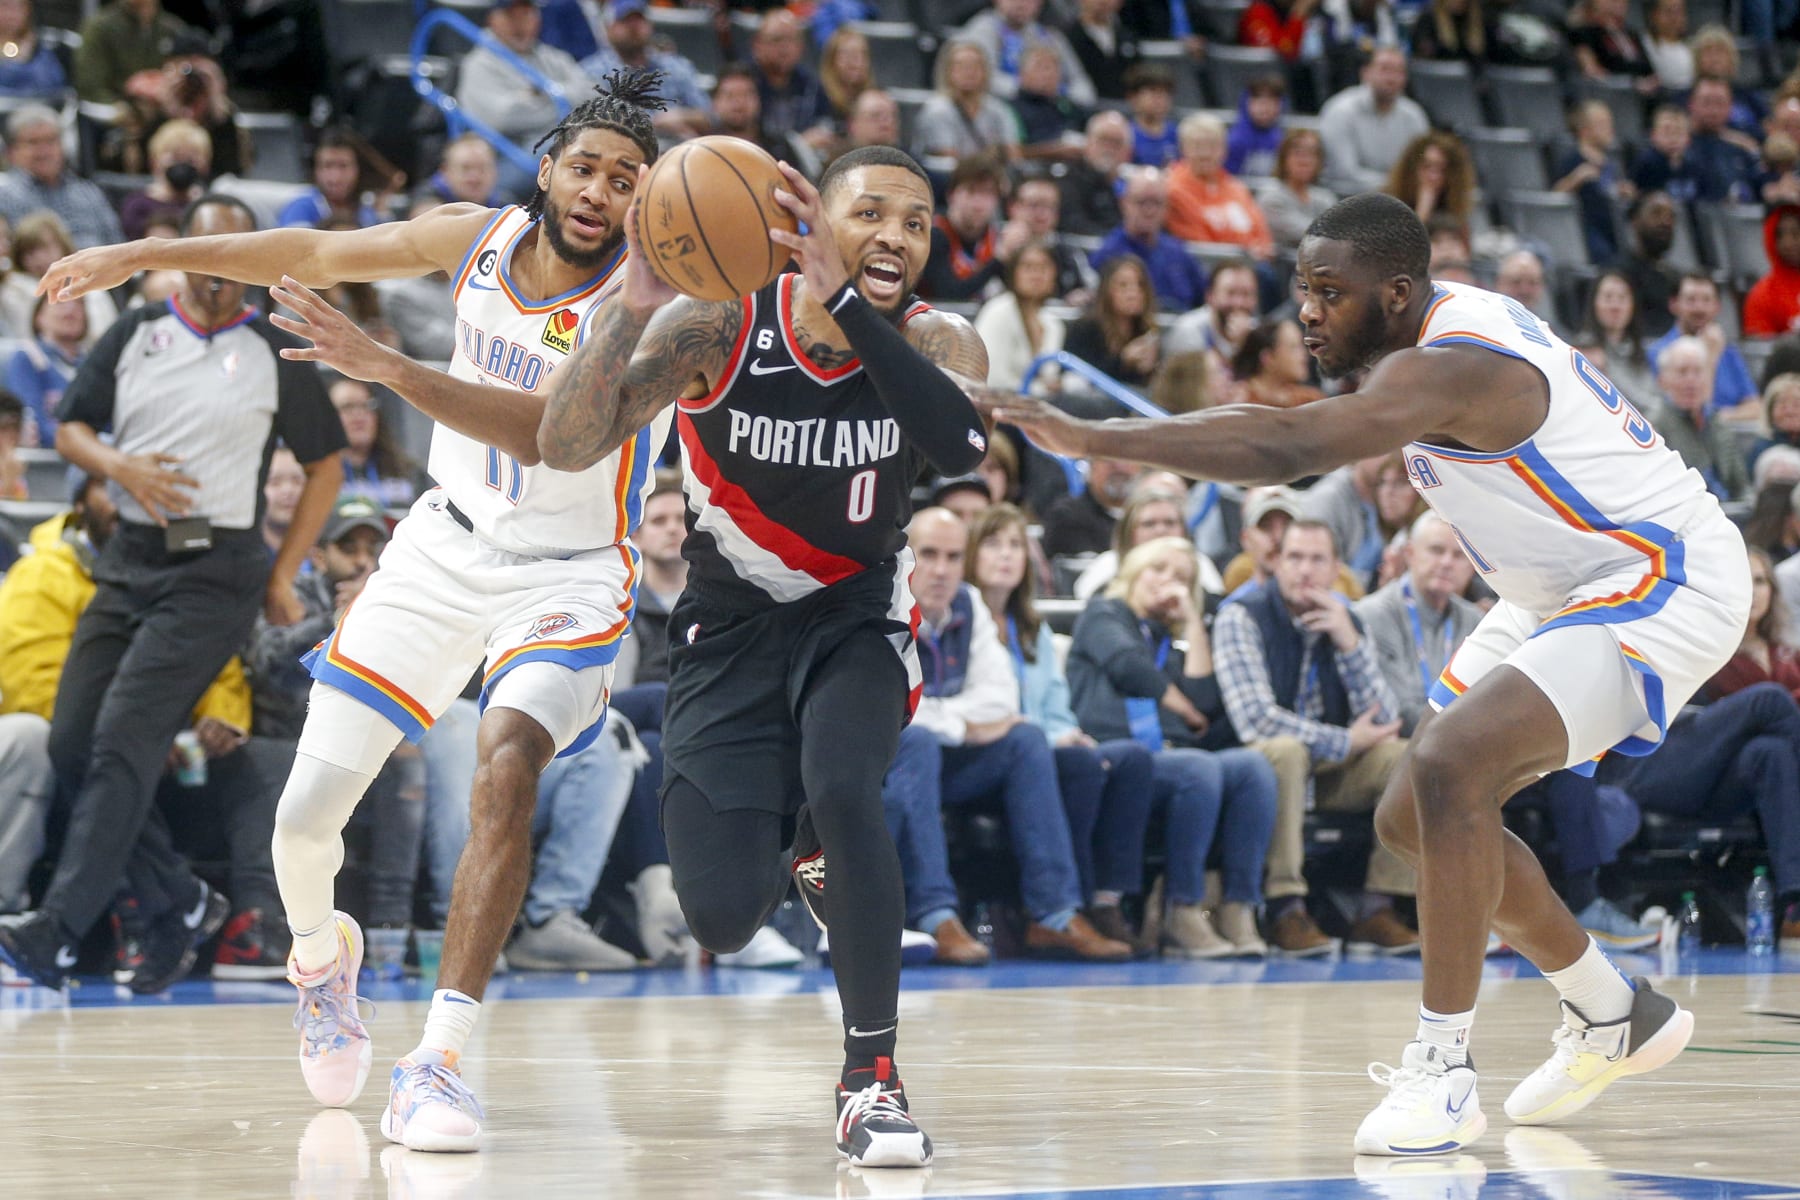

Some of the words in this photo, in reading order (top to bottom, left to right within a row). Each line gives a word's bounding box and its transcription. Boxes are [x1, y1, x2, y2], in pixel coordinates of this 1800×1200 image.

[480, 251, 497, 273] 6
[756, 328, 775, 350] 6
[727, 408, 900, 468] PORTLAND
[847, 468, 878, 523] 0
